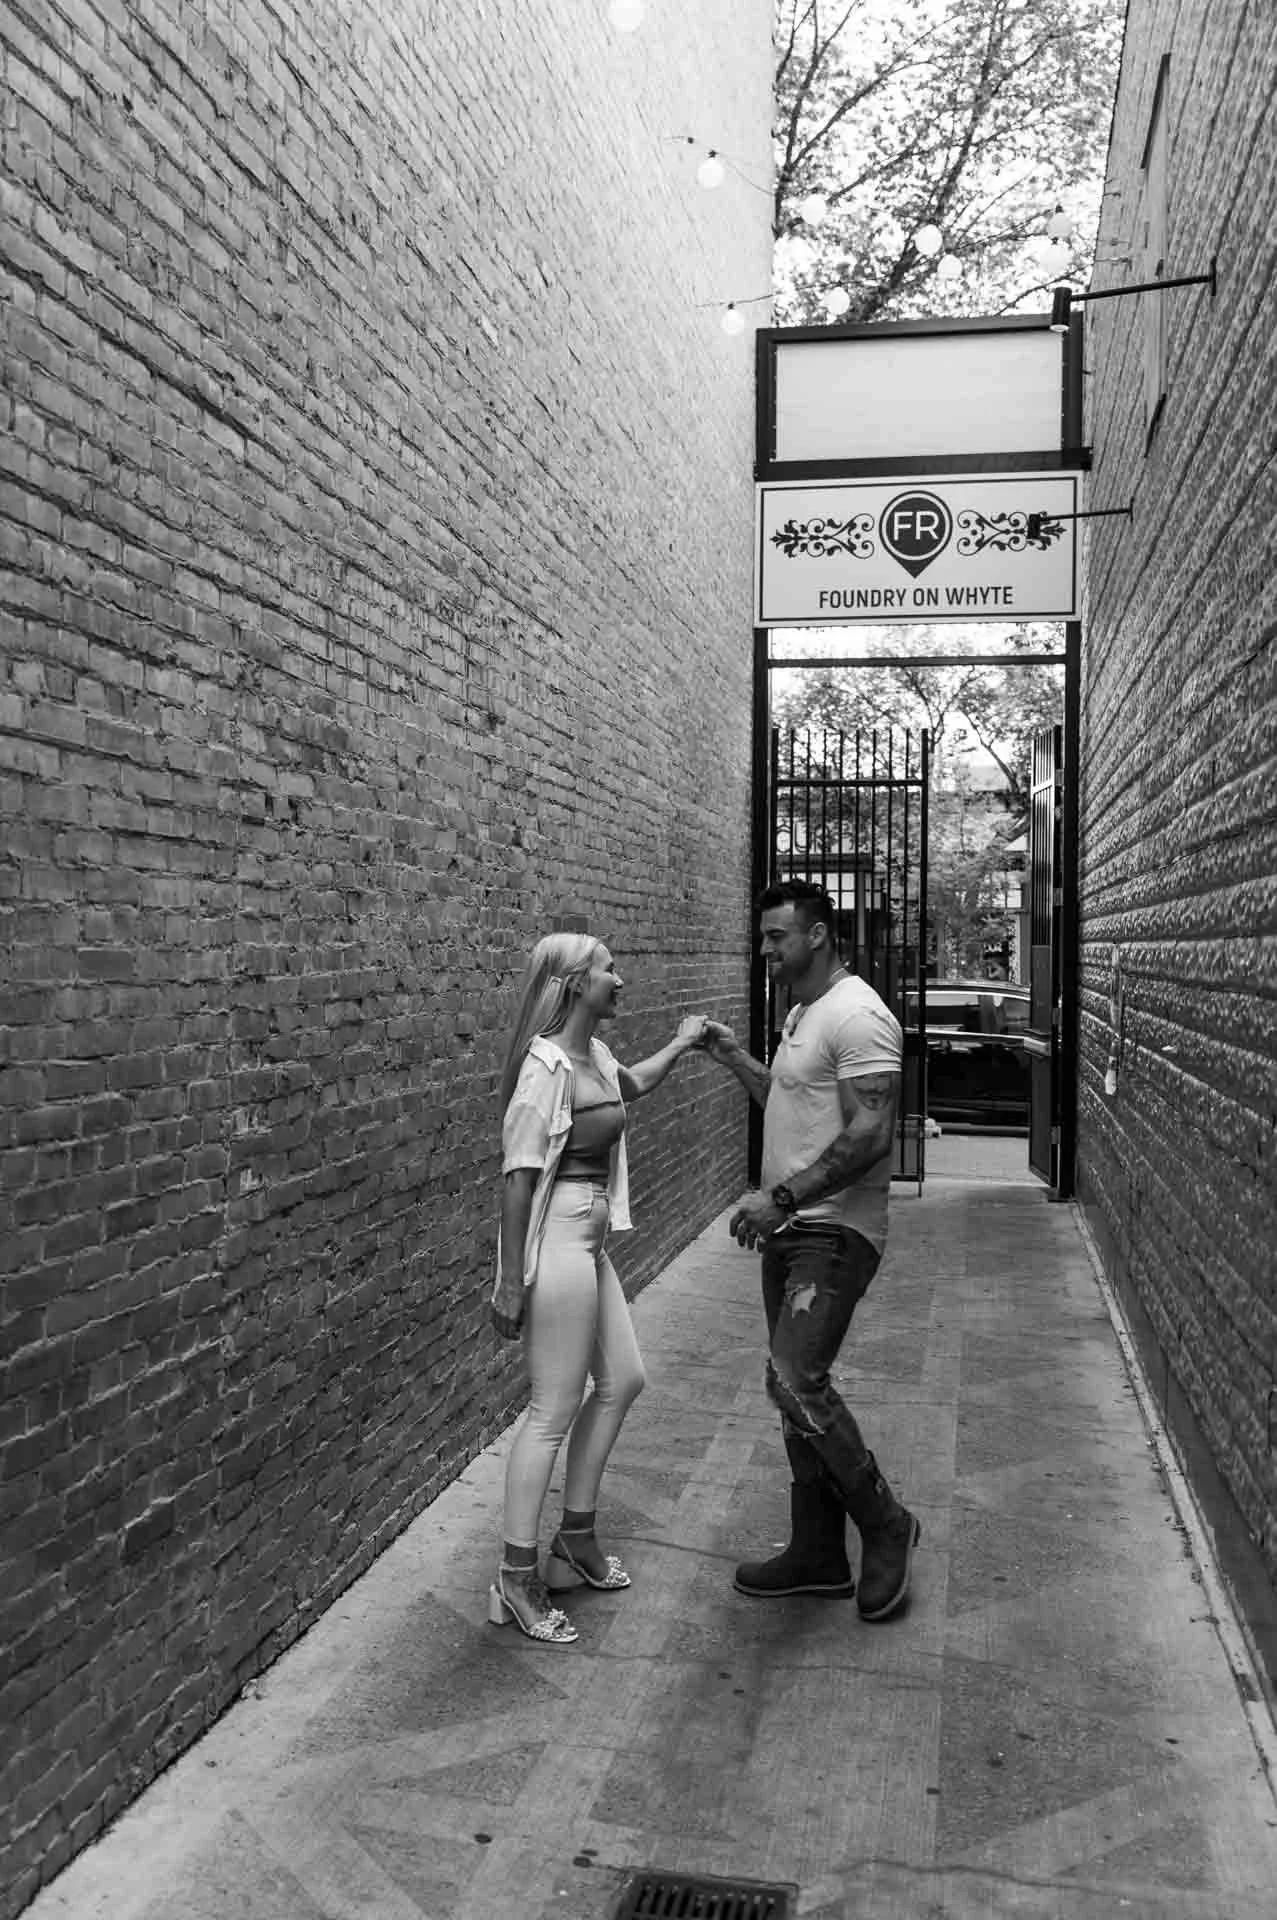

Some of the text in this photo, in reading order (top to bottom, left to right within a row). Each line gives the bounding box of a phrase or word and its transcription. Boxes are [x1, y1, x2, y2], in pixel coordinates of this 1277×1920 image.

[893, 510, 939, 541] FR
[819, 585, 1013, 609] FOUNDRY ON WHYTE
